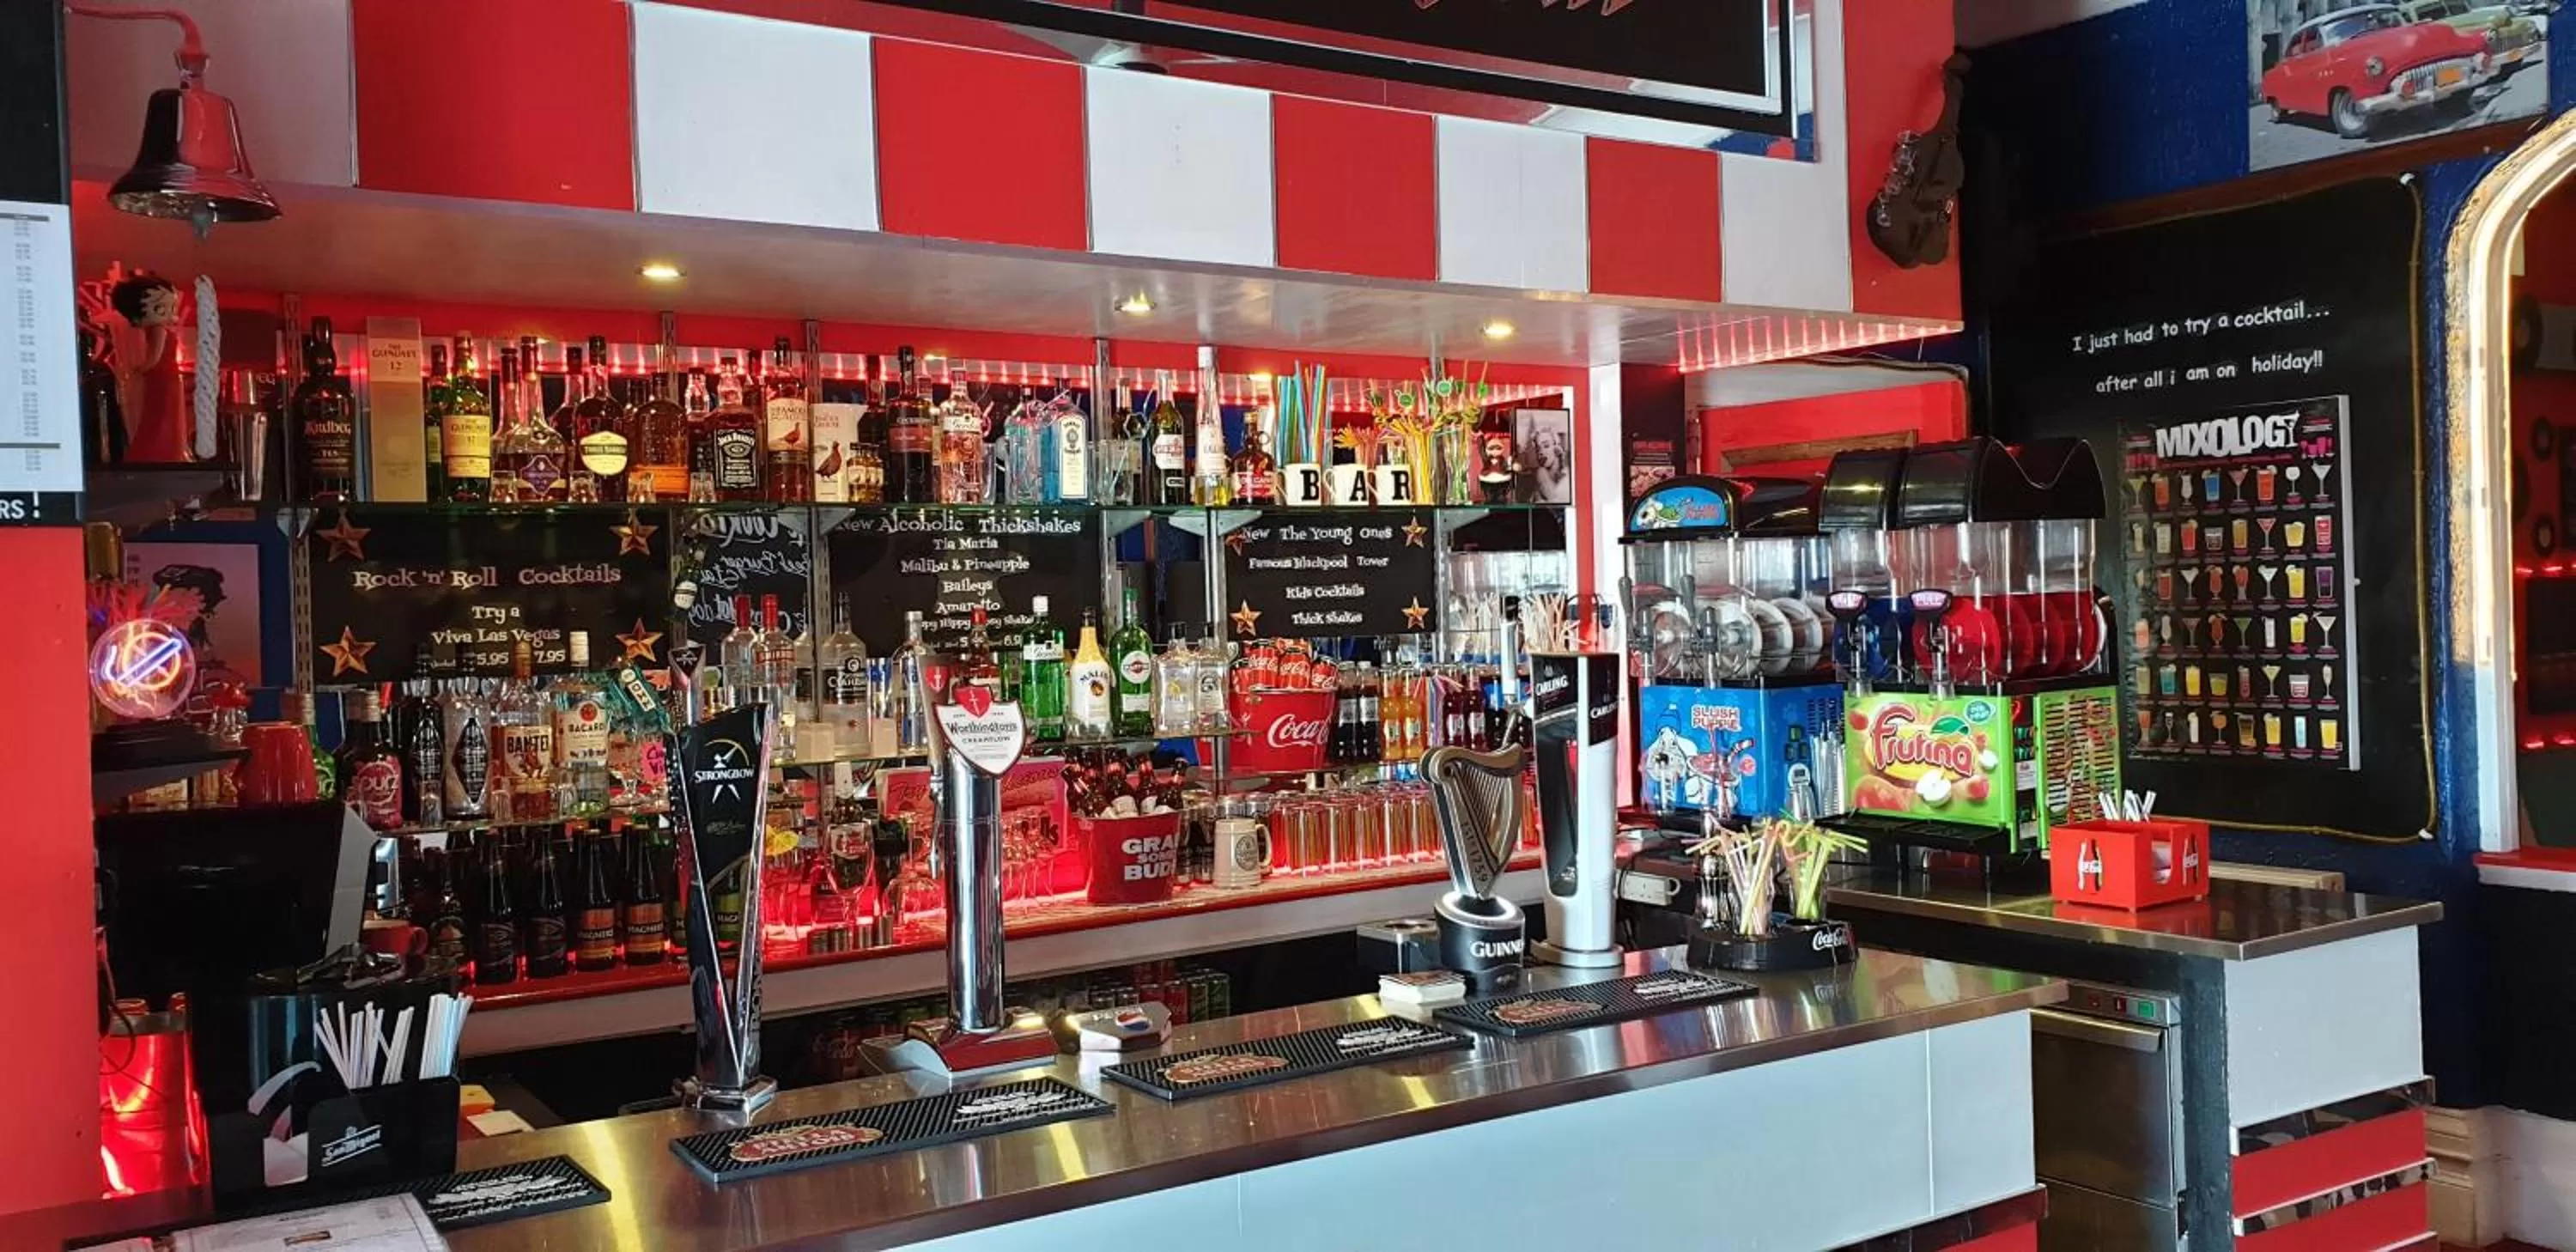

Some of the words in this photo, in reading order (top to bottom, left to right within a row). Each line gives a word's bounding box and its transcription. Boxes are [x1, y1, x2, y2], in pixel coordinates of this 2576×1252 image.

[2072, 336, 2082, 351] I
[2087, 332, 2118, 354] just
[2124, 325, 2154, 344] had
[2162, 322, 2178, 337] to
[2184, 317, 2211, 335] try
[2218, 316, 2229, 327] a
[2096, 376, 2138, 393] after
[2144, 371, 2163, 388] all
[2186, 366, 2209, 381] am
[2216, 364, 2236, 378] on
[2252, 350, 2324, 374] holiday!!
[2155, 410, 2300, 459] MIXOLOGY
[1300, 470, 1319, 500] B
[1350, 470, 1367, 500] A
[1391, 469, 1410, 500] R
[835, 518, 872, 532] New
[878, 514, 964, 534] Alcoholic
[978, 516, 1081, 534] Thickshakes
[933, 538, 955, 550] Tia
[958, 538, 999, 550] Maria
[1279, 526, 1307, 539] The
[1309, 526, 1352, 545] Young
[1360, 526, 1393, 538] Ones
[901, 559, 949, 574] Malibu
[952, 560, 961, 571] &
[964, 557, 1030, 575] Pineapple
[1249, 557, 1292, 570] Famous
[1294, 556, 1348, 571] Blackpool
[1357, 556, 1389, 567] Tower
[351, 568, 416, 591] Rock
[451, 566, 498, 590] Roll
[518, 563, 621, 586] Cocktails
[943, 579, 993, 598] Baileys
[1285, 586, 1312, 599] Kids
[1315, 584, 1365, 598] Cocktails
[471, 605, 506, 623] Try
[510, 606, 520, 618] a
[935, 599, 1000, 615] Amartto
[1291, 612, 1324, 625] Thick
[1325, 611, 1363, 623] Shakes
[432, 629, 472, 646] Viva
[477, 628, 507, 643] Las
[512, 628, 561, 648] Vegas
[477, 652, 509, 666] 5.95
[533, 649, 566, 665] 7.95
[1693, 707, 1738, 719] SLUSH
[695, 769, 755, 783] STRONGBOW
